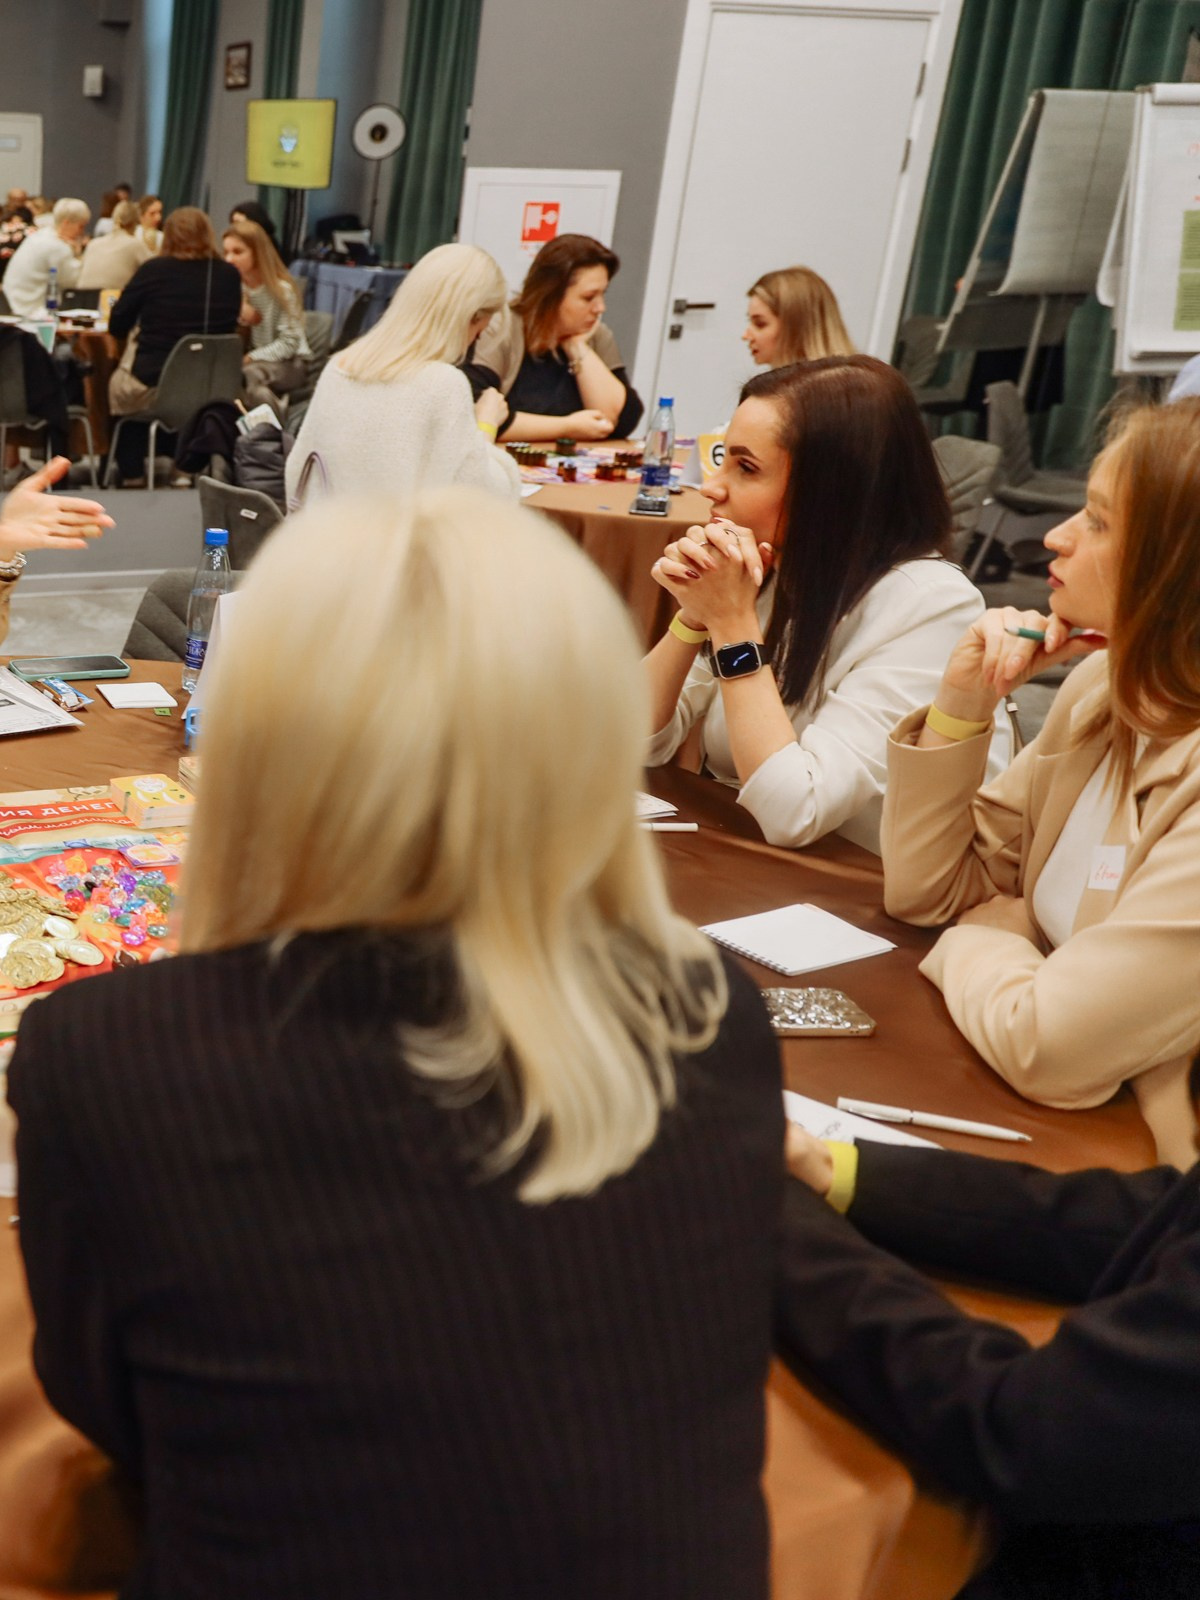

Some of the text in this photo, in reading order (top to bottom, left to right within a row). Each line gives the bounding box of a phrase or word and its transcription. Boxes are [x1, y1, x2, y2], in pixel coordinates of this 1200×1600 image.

[712, 444, 724, 466] 6
[41, 802, 114, 816] ДЕНЕГ
[44, 817, 134, 829] магнито
